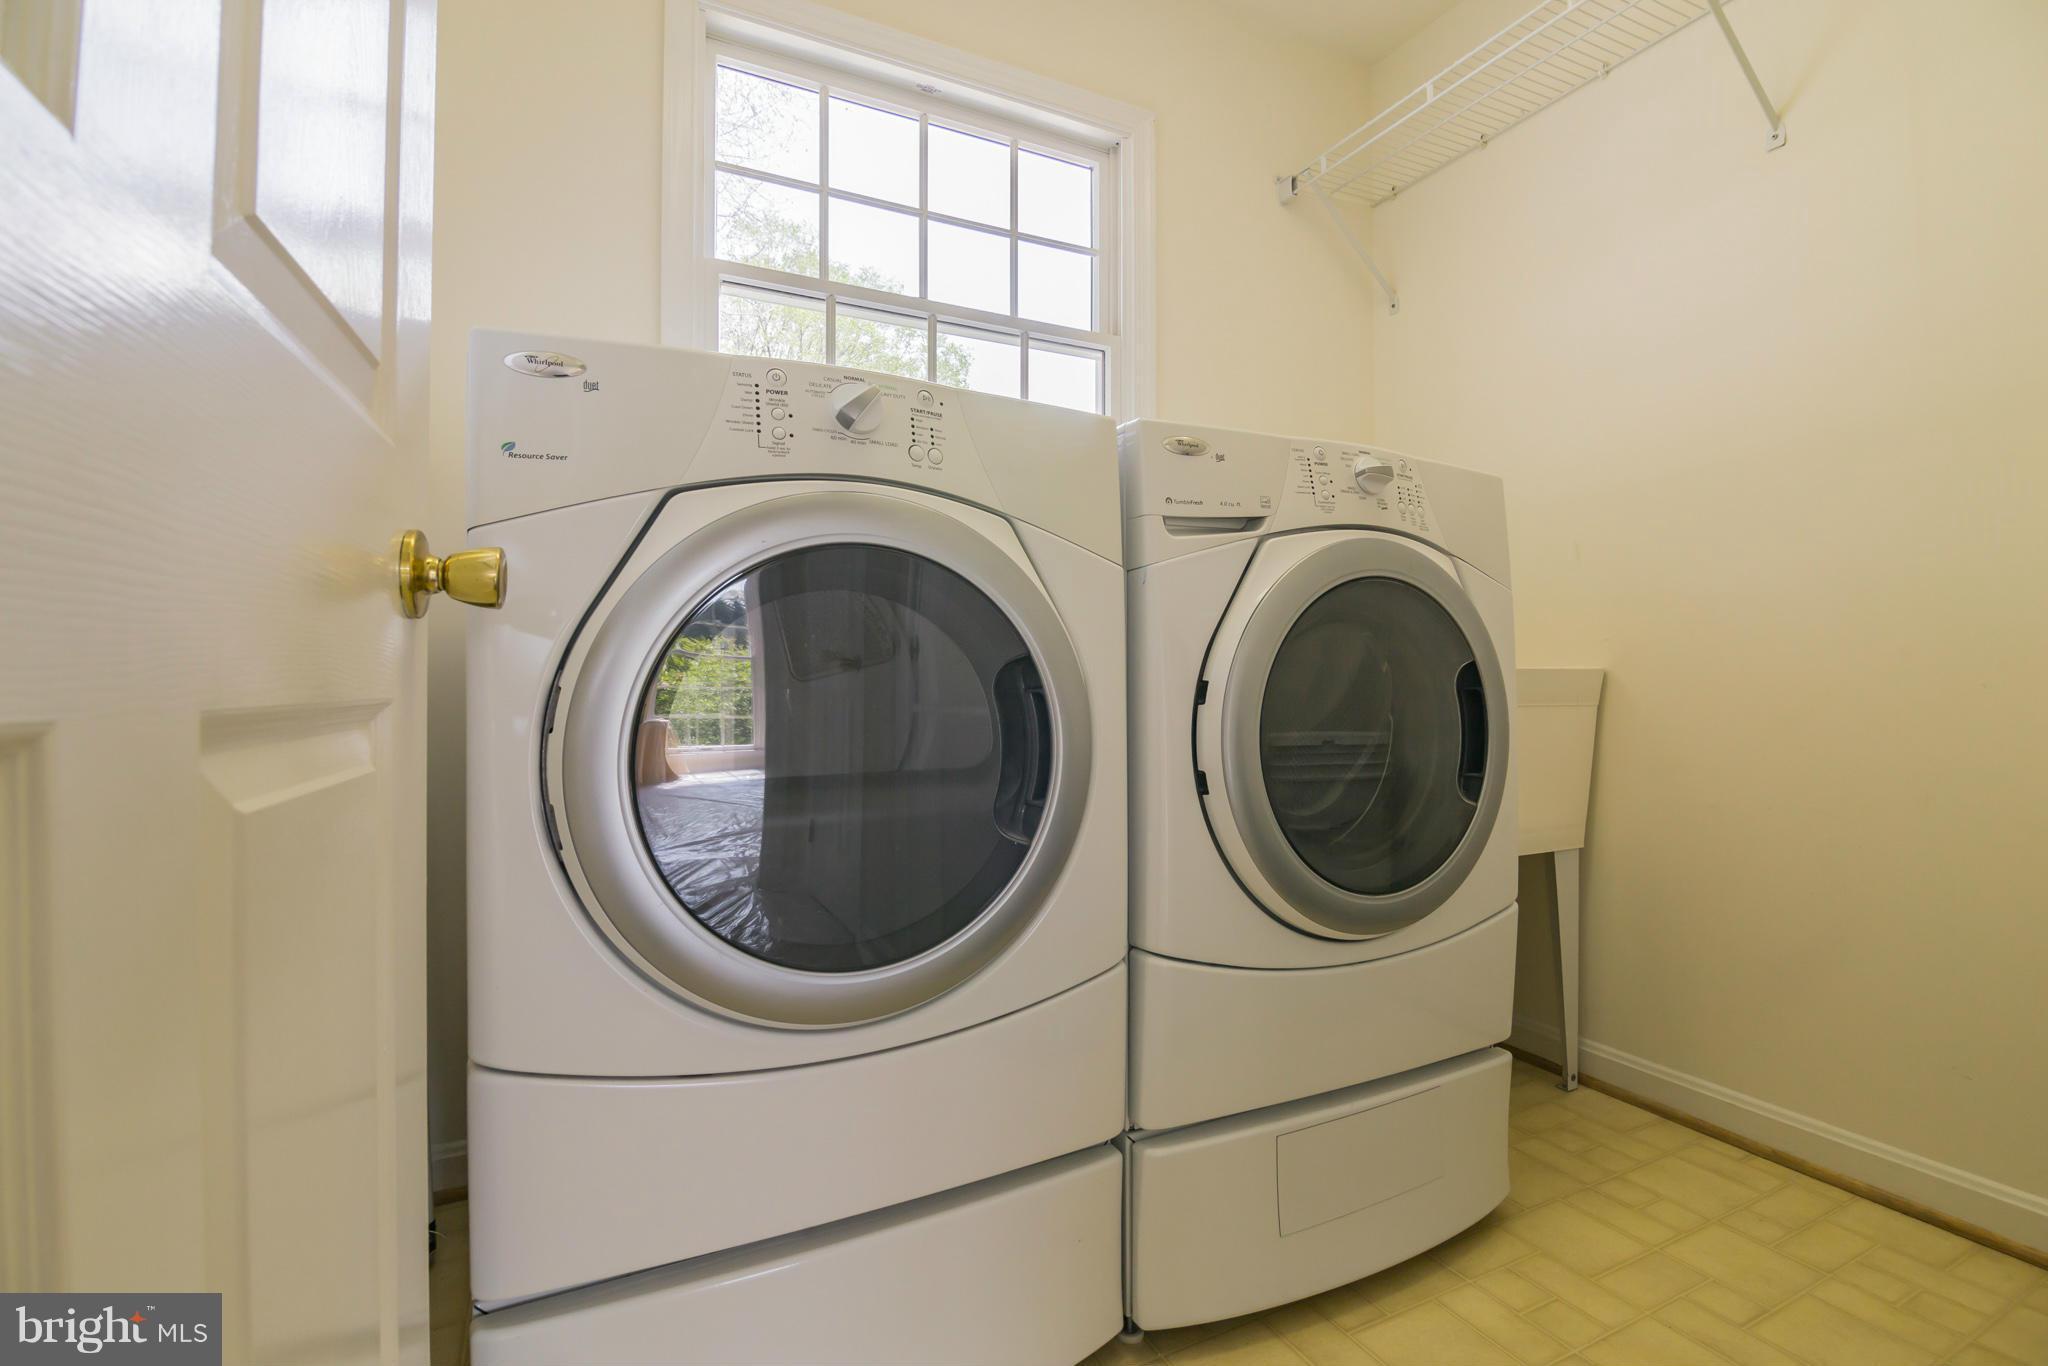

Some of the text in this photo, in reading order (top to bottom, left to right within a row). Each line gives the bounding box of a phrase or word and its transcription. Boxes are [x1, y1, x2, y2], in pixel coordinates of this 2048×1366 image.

[526, 357, 564, 368] Whirlpool
[843, 375, 866, 383] NORMAL
[583, 379, 600, 392] duet
[910, 407, 943, 418] START/PAUSE
[508, 452, 568, 461] Resource Saver
